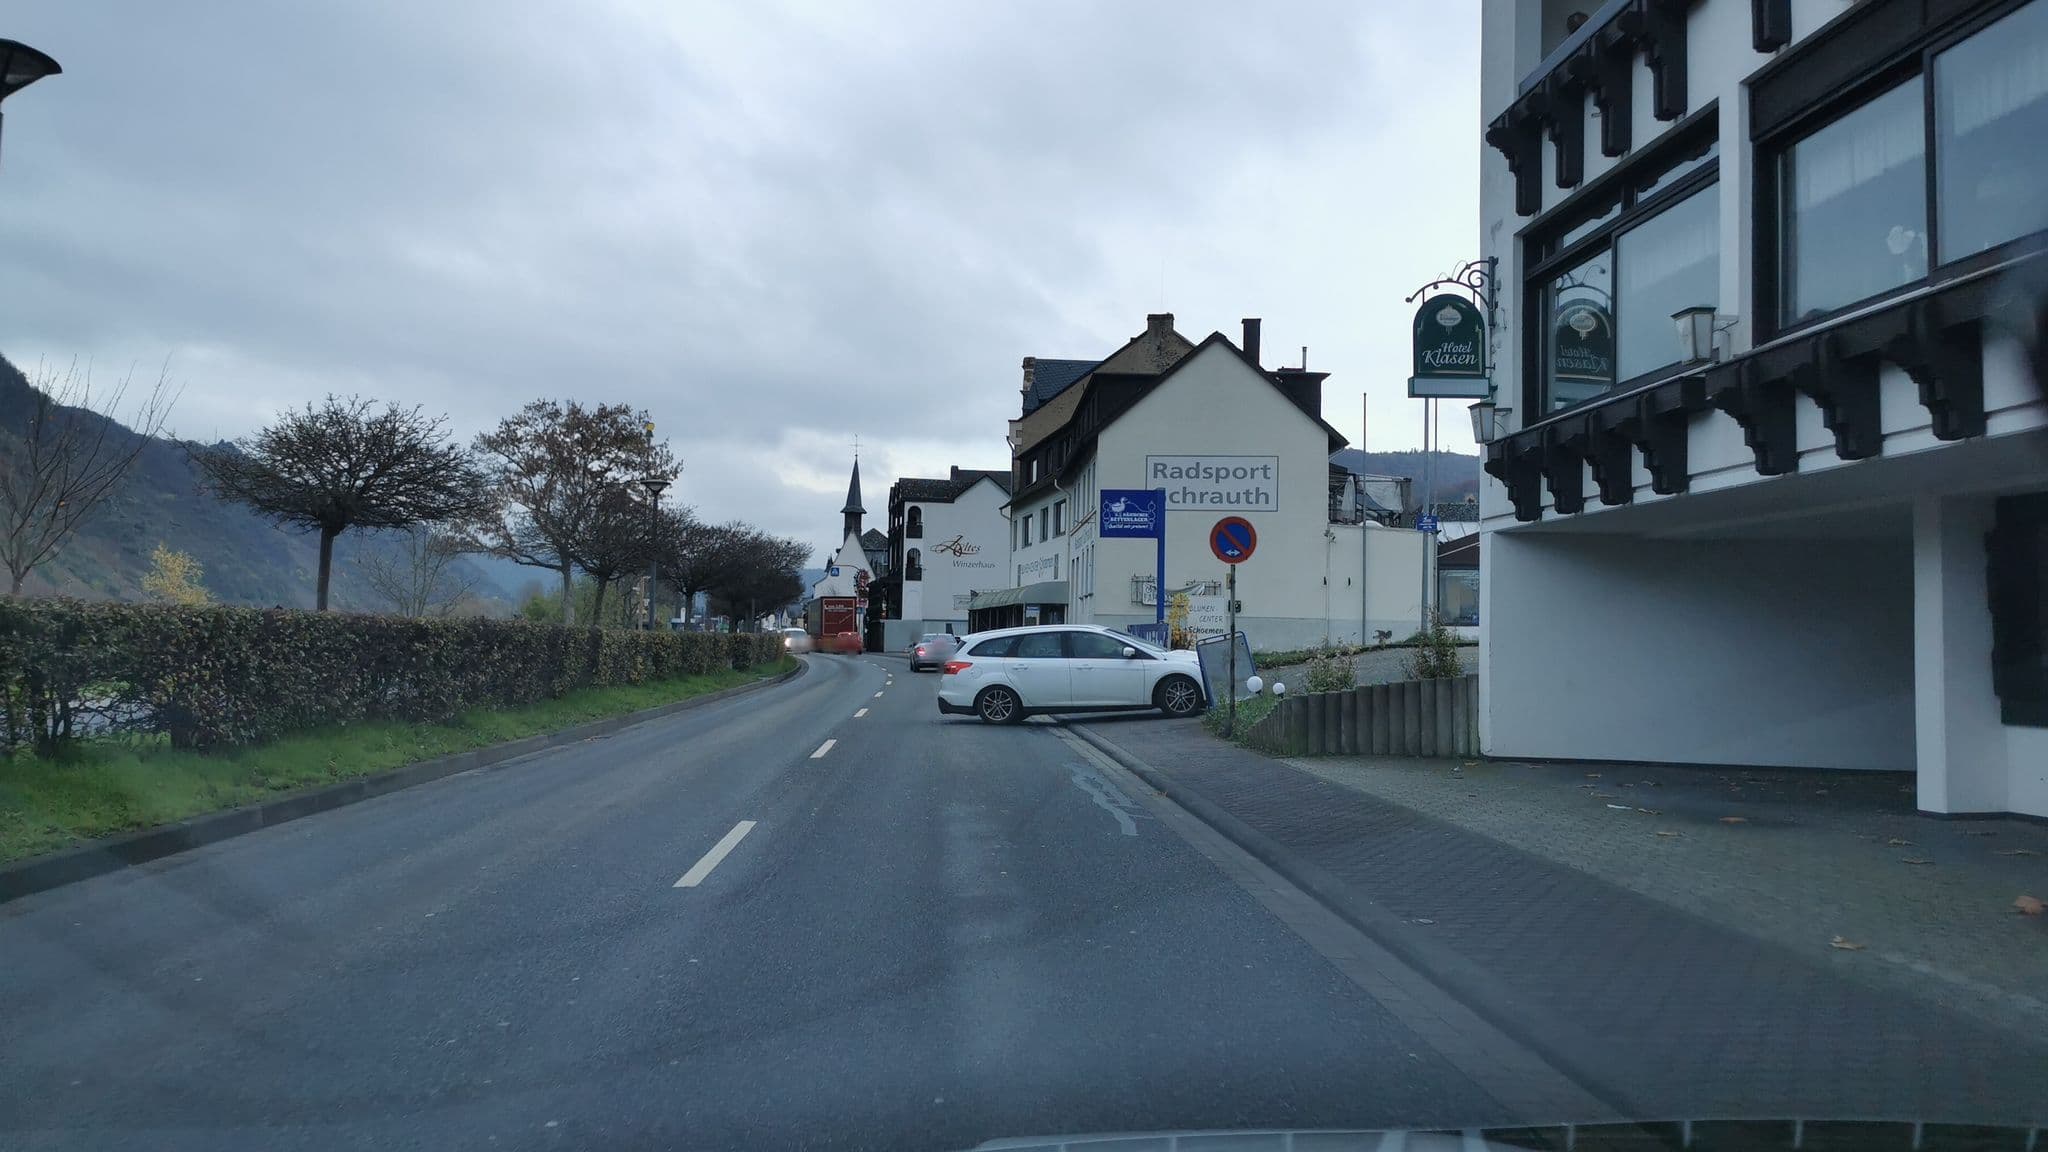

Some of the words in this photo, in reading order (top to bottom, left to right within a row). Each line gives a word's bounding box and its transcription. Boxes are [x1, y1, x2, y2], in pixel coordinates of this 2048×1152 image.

[1441, 341, 1472, 353] Hotel
[1422, 348, 1478, 367] Klasen
[1153, 462, 1271, 484] Radsport
[1168, 487, 1270, 505] chrauth
[1199, 615, 1224, 623] CENTER
